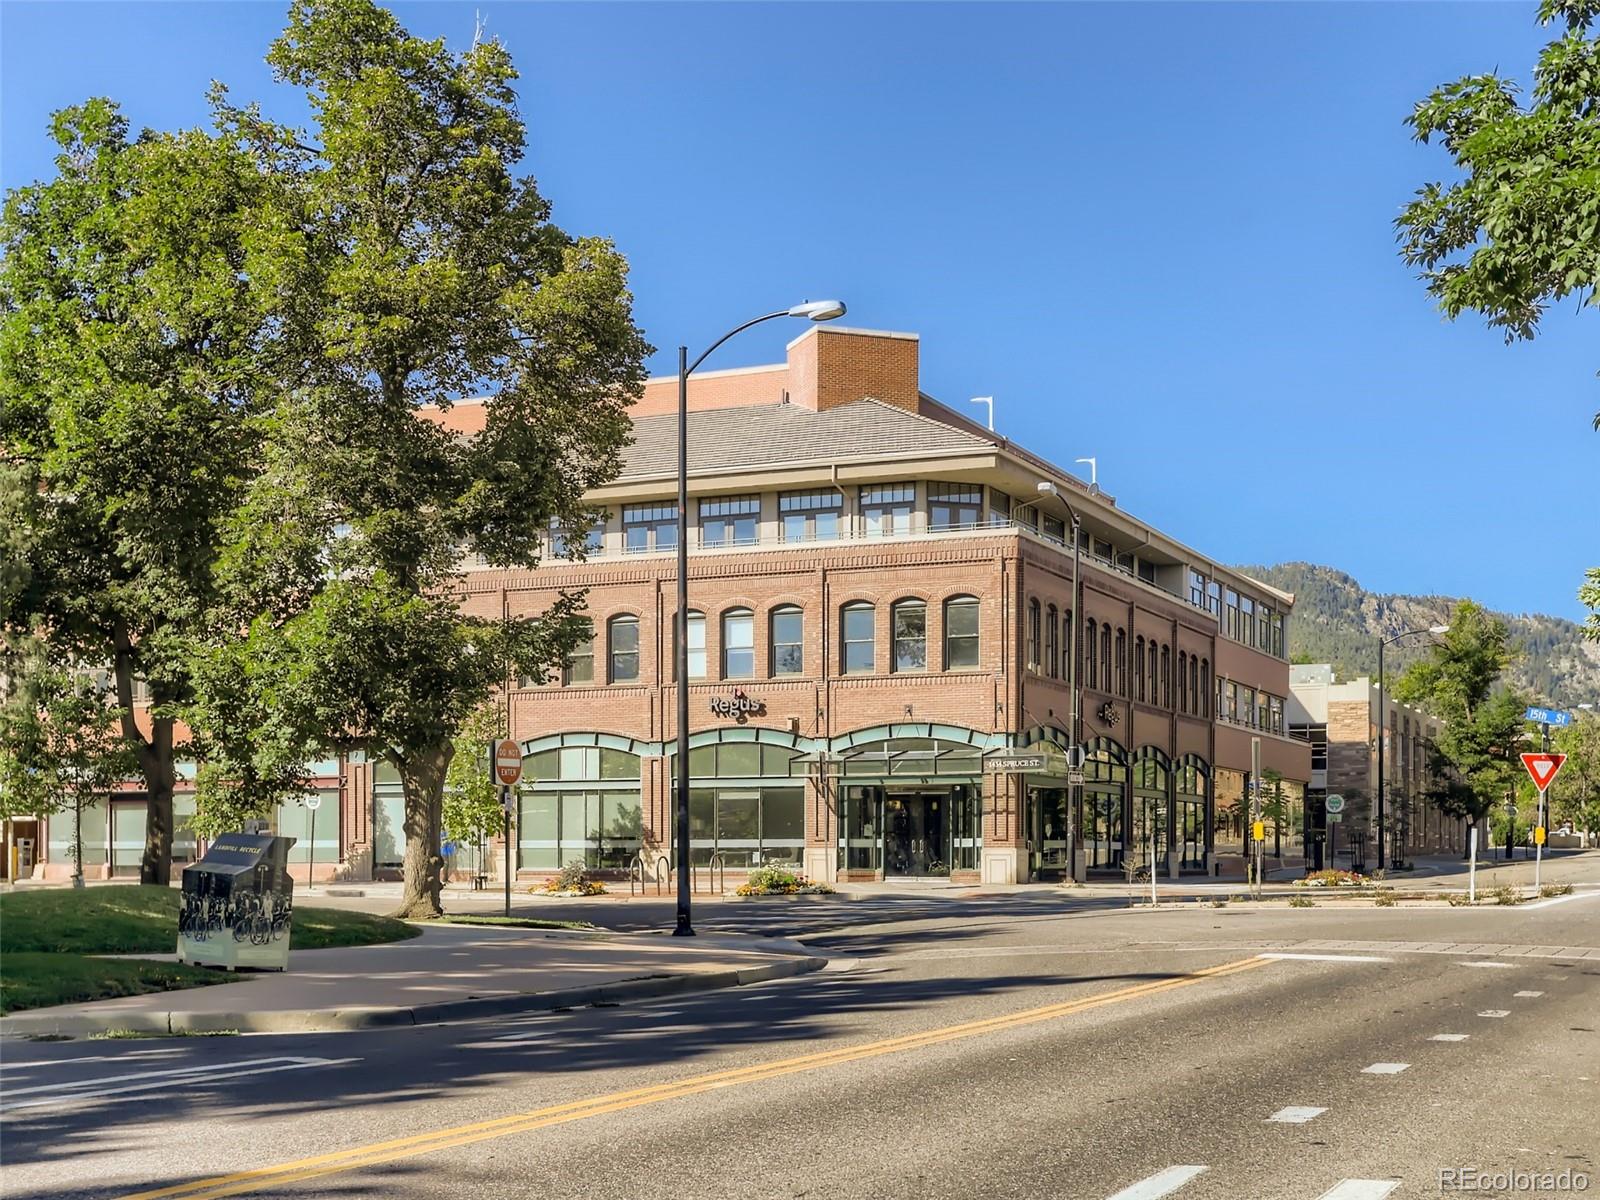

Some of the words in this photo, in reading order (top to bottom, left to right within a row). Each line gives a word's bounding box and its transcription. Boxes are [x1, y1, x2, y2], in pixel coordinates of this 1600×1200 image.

[709, 696, 760, 719] Regus
[1530, 709, 1547, 720] 15th
[1555, 713, 1565, 723] St
[499, 748, 507, 756] DO
[508, 749, 518, 757] NOT
[501, 768, 517, 777] ENTER
[239, 846, 262, 854] RECYCLE
